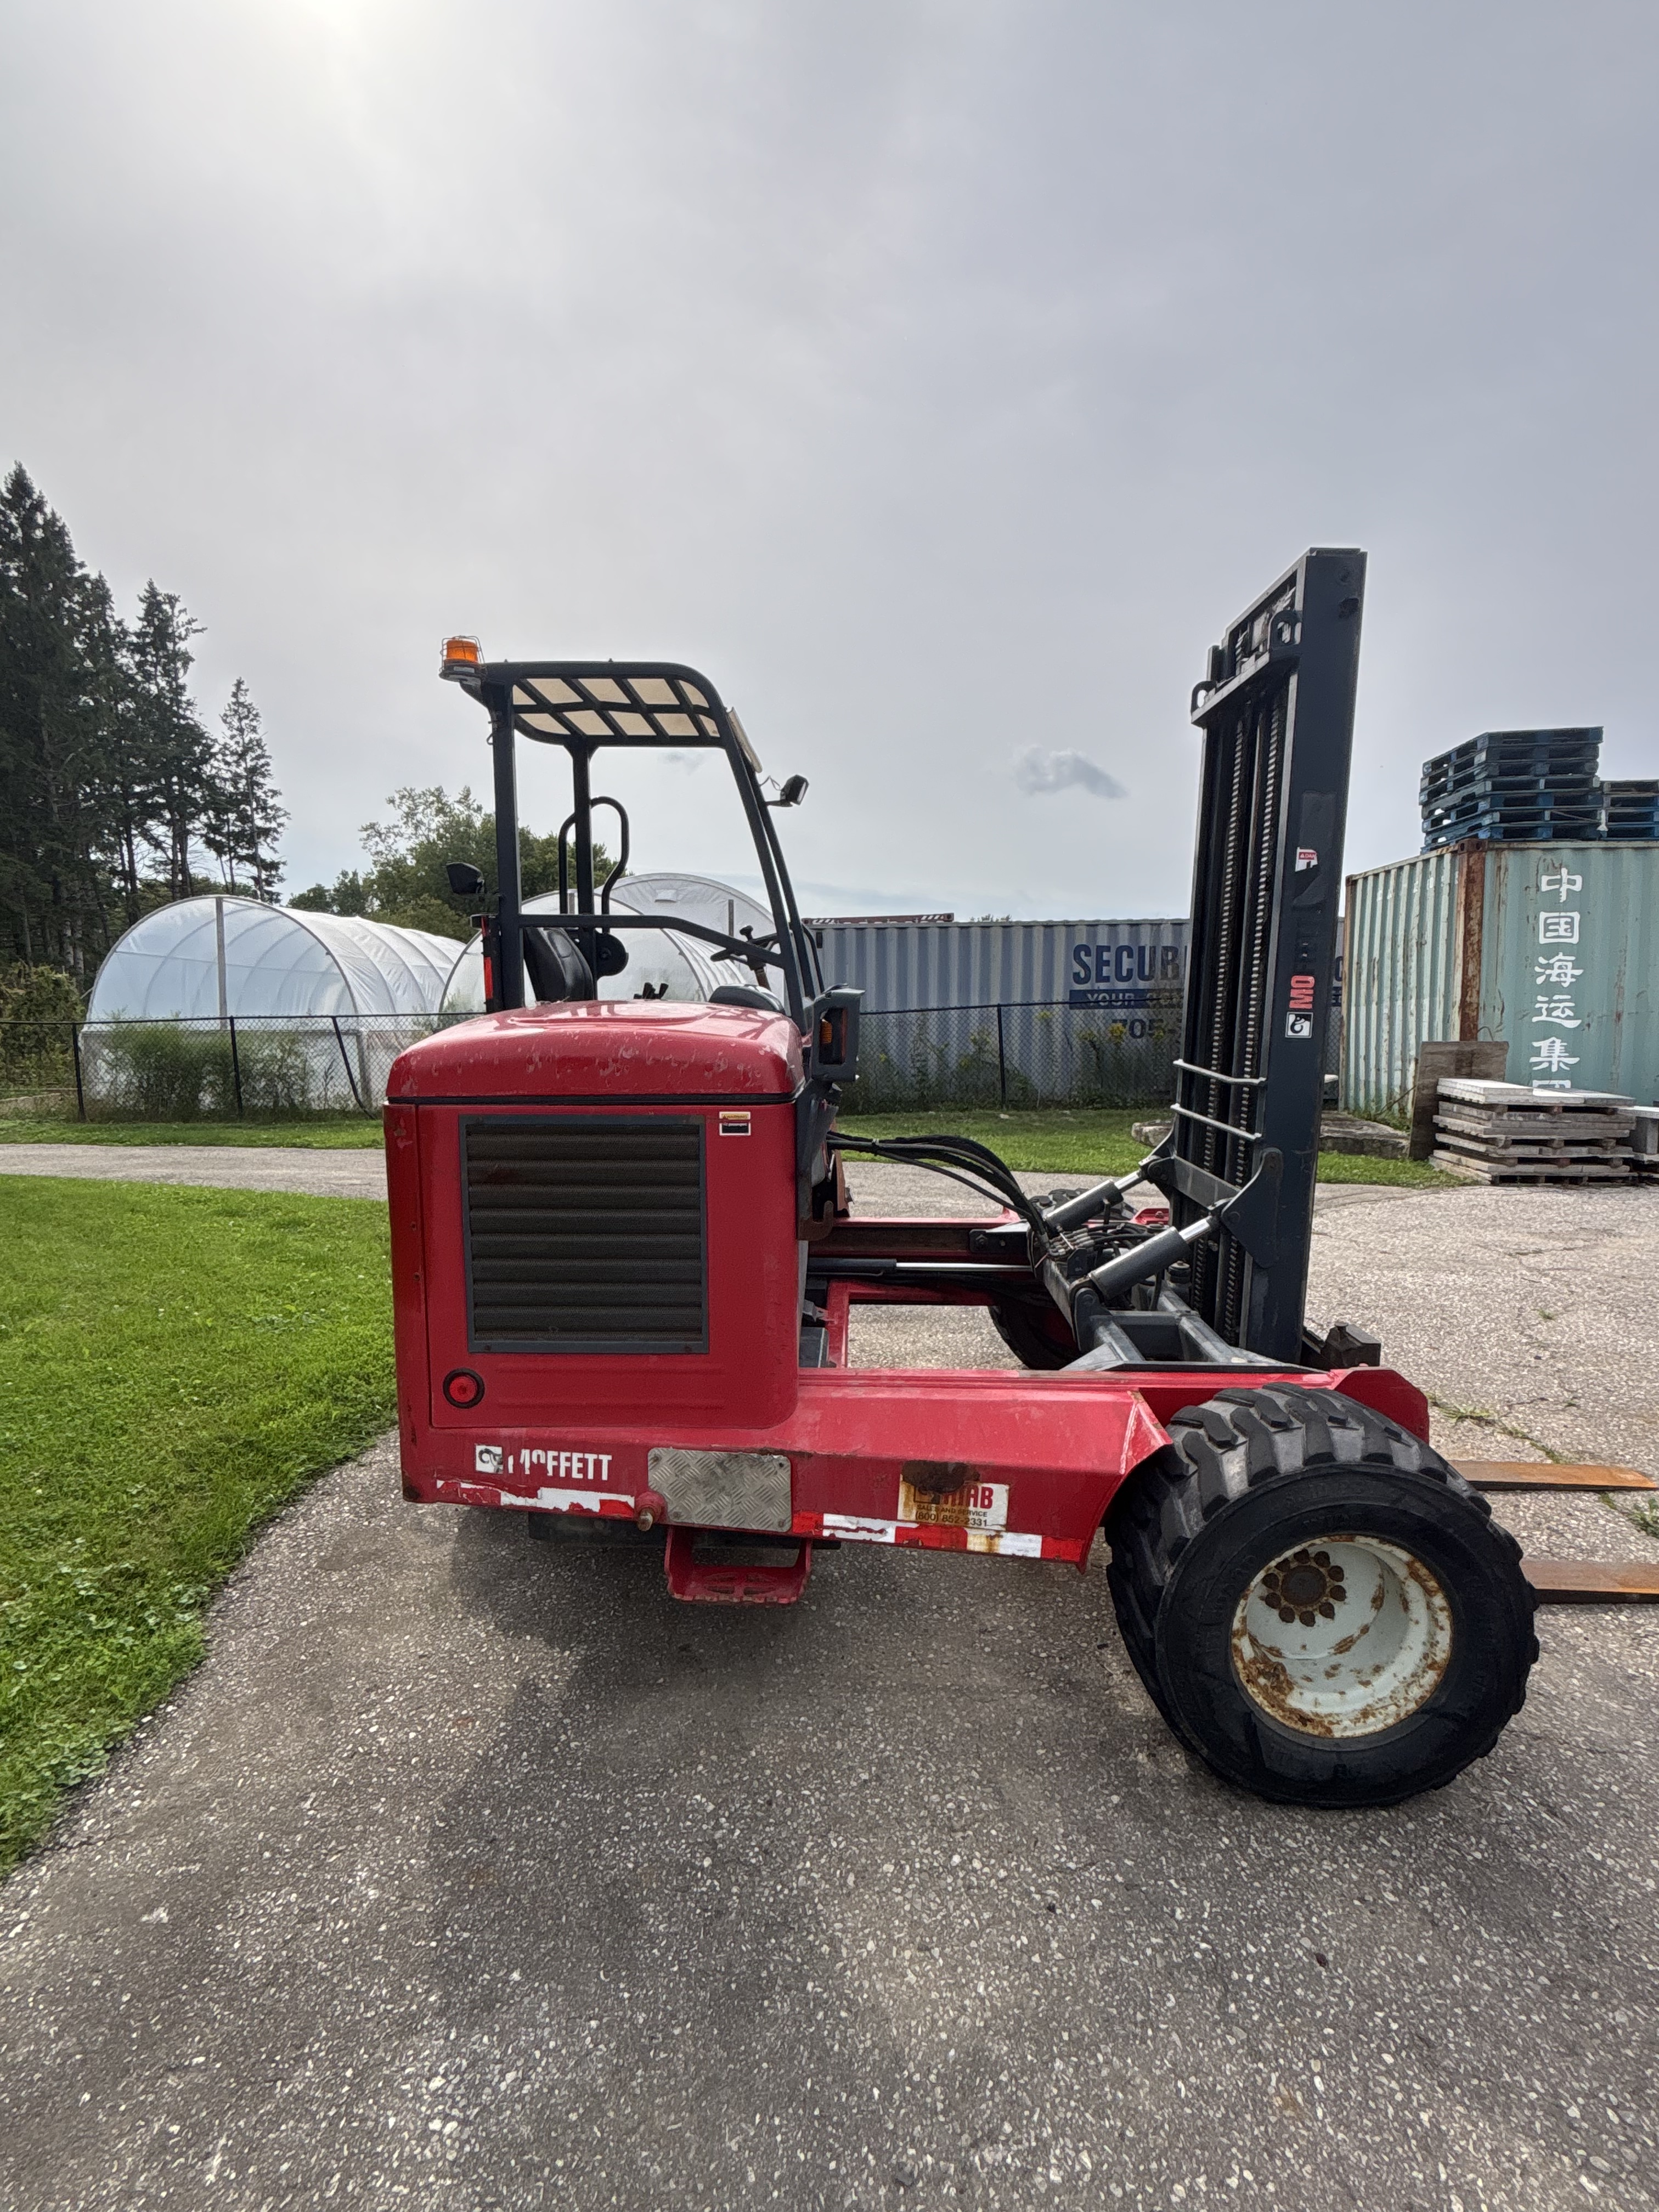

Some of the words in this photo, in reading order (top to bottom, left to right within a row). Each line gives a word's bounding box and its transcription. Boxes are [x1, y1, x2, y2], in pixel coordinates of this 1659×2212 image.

[1073, 944, 1187, 985] SECUR
[1529, 867, 1584, 1088] 中国海运集
[1087, 993, 1135, 1006] YOUR
[915, 1510, 939, 1522] (800)
[941, 1514, 987, 1527] 852-2331
[958, 1509, 988, 1517] SERVICE
